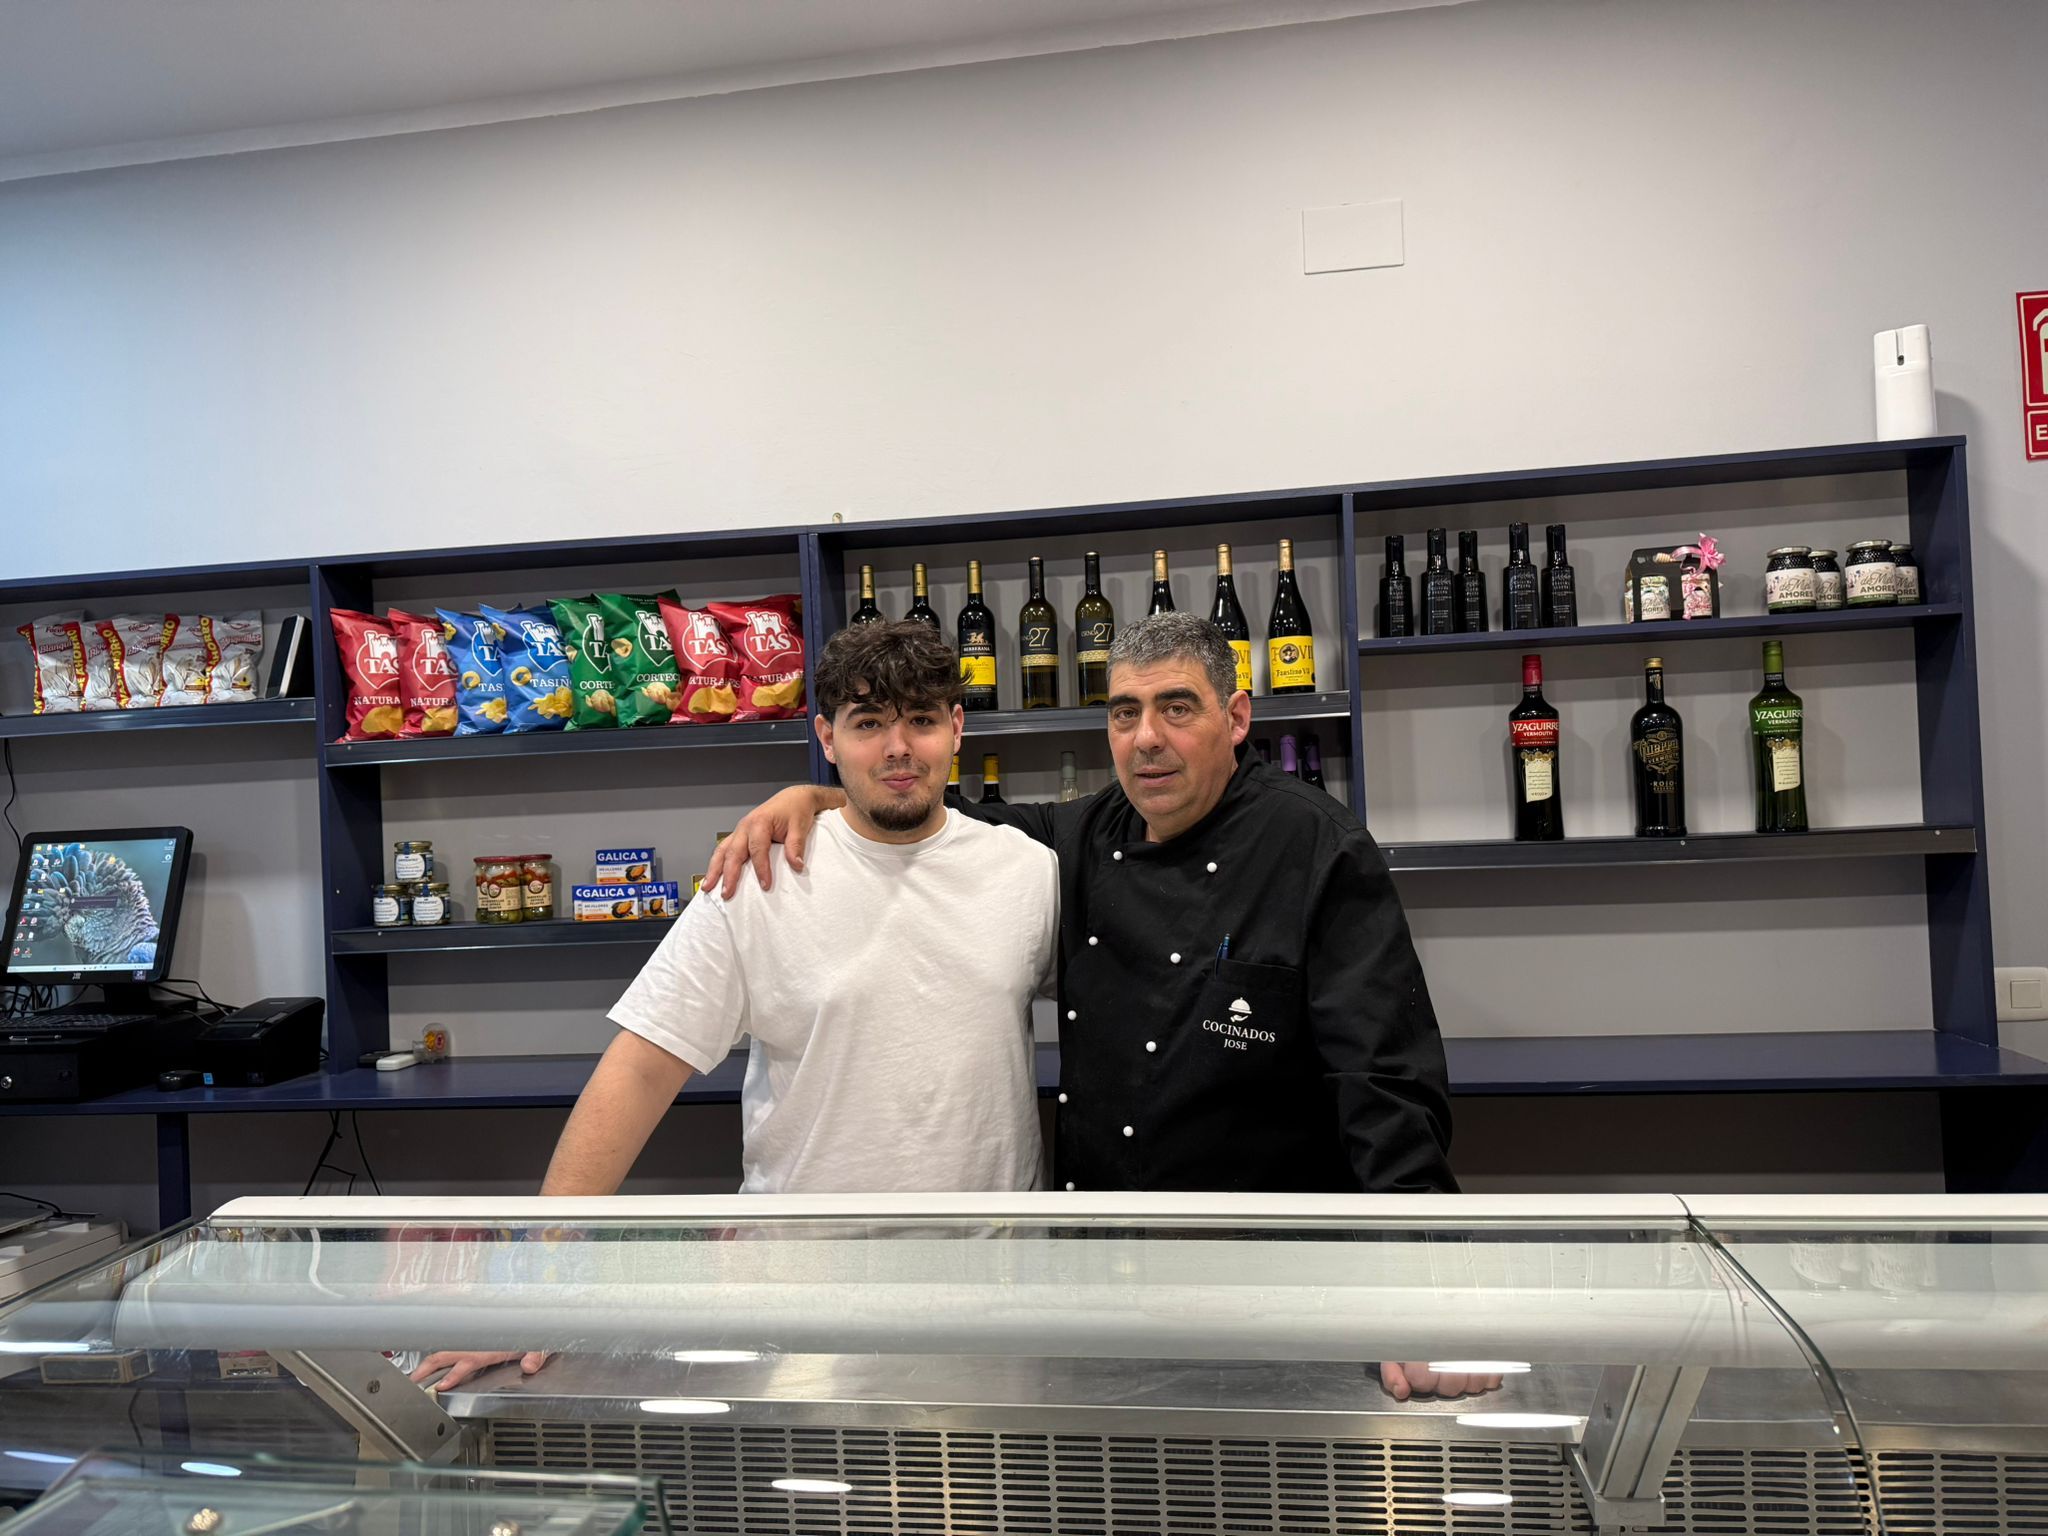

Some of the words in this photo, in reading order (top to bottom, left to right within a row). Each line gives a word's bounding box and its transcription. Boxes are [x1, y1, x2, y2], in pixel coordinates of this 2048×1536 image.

[1779, 590, 1814, 599] AMORES
[1860, 584, 1896, 594] AMORES
[1896, 588, 1917, 596] ORES
[1028, 627, 1050, 647] 27
[1093, 622, 1112, 642] 27
[689, 638, 728, 656] TAS
[750, 633, 792, 652] TAS
[479, 682, 504, 692] TAS
[530, 675, 572, 688] TASIÑ
[354, 695, 401, 706] NATURA
[410, 696, 456, 707] NATURA
[597, 851, 638, 862] GALICA
[582, 888, 625, 898] GALICA
[641, 884, 658, 895] LICA
[1202, 1019, 1276, 1043] COCINADOS
[1223, 1038, 1248, 1050] JOSE
